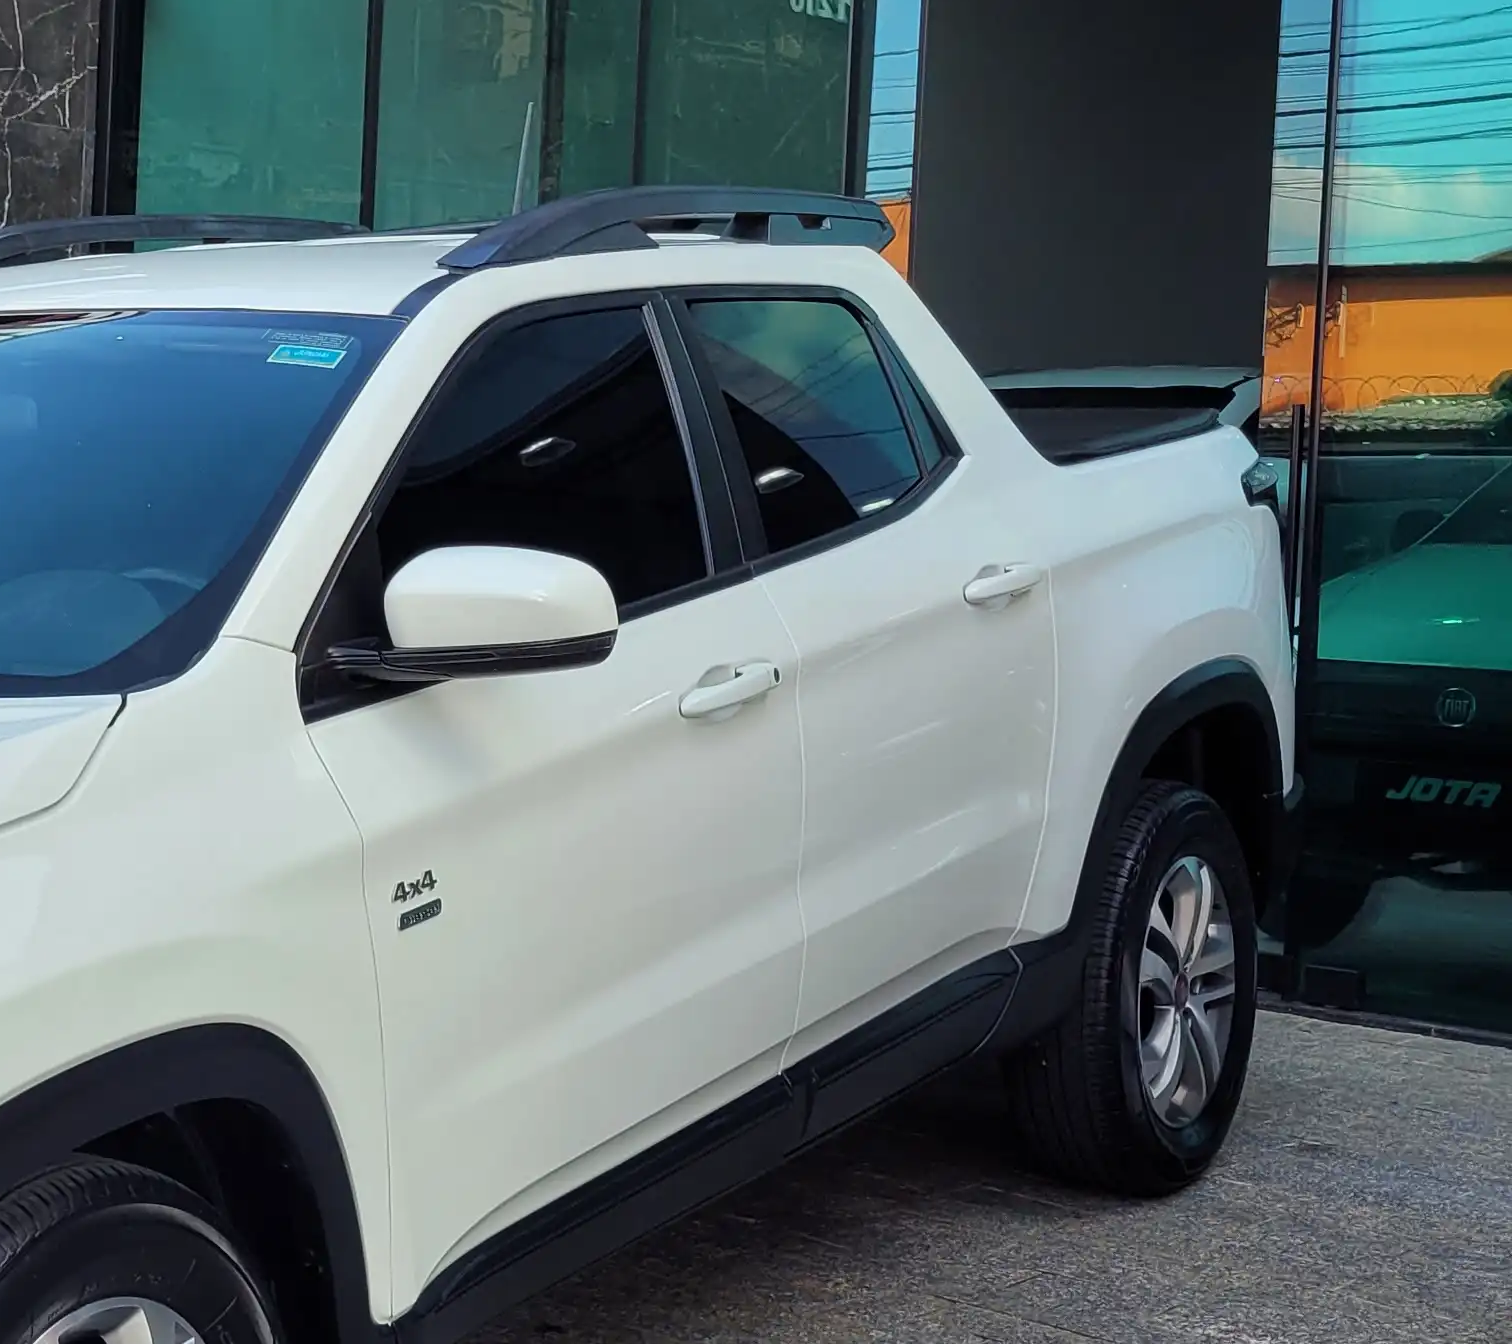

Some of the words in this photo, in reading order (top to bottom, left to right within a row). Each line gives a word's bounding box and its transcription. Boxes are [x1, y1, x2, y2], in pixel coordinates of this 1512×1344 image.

[1443, 698, 1470, 718] FIAT
[1385, 774, 1503, 809] JOTA
[392, 868, 438, 904] 4x4
